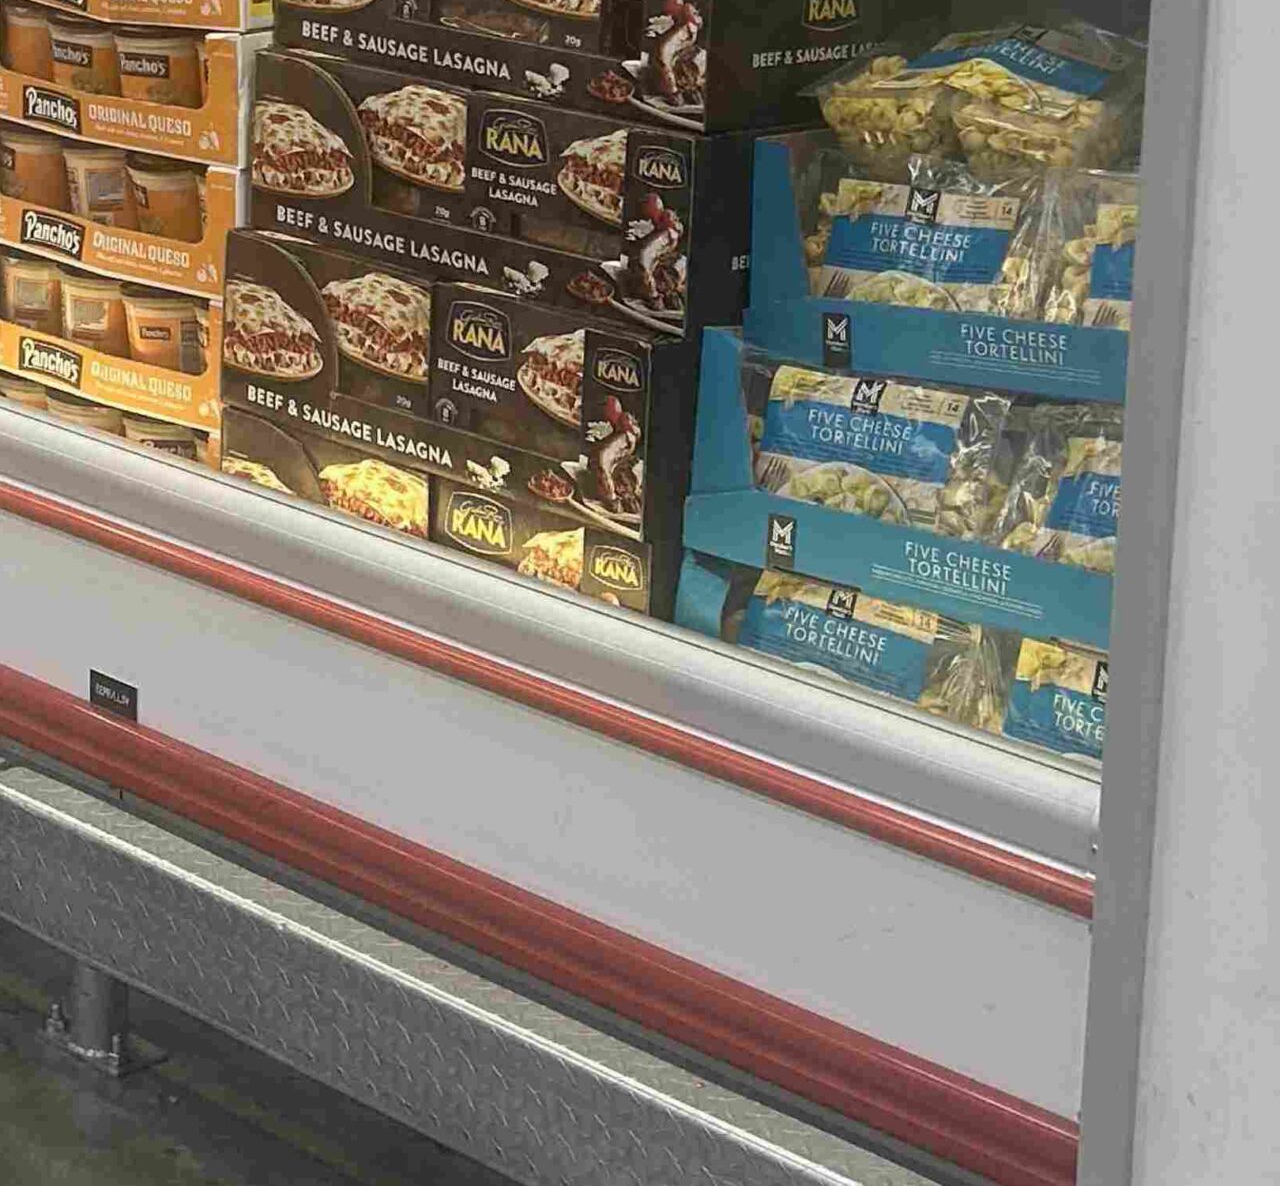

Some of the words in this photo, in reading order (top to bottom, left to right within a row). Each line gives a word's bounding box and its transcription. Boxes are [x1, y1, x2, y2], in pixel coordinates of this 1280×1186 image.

[301, 20, 337, 44] BEEF
[342, 28, 354, 46] &
[357, 30, 430, 67] SAUSAGE
[433, 46, 511, 82] LASAGNA
[752, 51, 782, 69] BEEF
[784, 52, 794, 65] &
[796, 45, 848, 63] SAUSAGE
[88, 103, 147, 129] ORIGINAL
[148, 114, 192, 136] QUESO
[485, 126, 542, 161] RANA
[471, 166, 497, 185] BEEF
[499, 171, 508, 185] &
[510, 172, 557, 196] SAUSAGE
[638, 156, 682, 182] RANA
[489, 184, 538, 208] LASAGNA
[24, 212, 80, 254] Pancho's
[148, 245, 190, 267] QUESO
[276, 205, 313, 229] BEEF
[318, 216, 329, 234] &
[334, 219, 406, 256] SAUSAGE
[410, 238, 489, 276] LASAGNA
[870, 221, 900, 238] FIVE
[904, 226, 971, 248] CHEESE
[872, 237, 964, 263] TORTELLINI
[452, 318, 506, 355] RANA
[960, 323, 996, 343] FIVE
[1002, 329, 1068, 351] CHEESE
[965, 340, 1064, 366] TORTELLINI
[21, 338, 80, 383] Pancho's
[148, 376, 192, 400] QUESO
[437, 358, 460, 374] BEEF
[473, 367, 516, 391] SAUSAGE
[597, 361, 641, 388] RANA
[451, 378, 498, 403] LASAGNA
[247, 386, 284, 411] BEEF
[287, 400, 299, 417] &
[302, 403, 373, 444] SAUSAGE
[376, 427, 453, 469] LASAGNA
[808, 408, 844, 429] FIVE
[850, 415, 912, 441] CHEESE
[810, 425, 904, 456] TORTELLINI
[452, 513, 506, 549] RANA
[595, 556, 638, 588] RANA
[904, 541, 941, 563] FIVE
[947, 551, 1012, 582] CHEESE
[908, 560, 1007, 596] TORTELLINI
[785, 606, 819, 632] FIVE
[825, 619, 887, 651] CHEESE
[785, 623, 880, 667] TORTELLINI
[1053, 692, 1087, 717] FIVE
